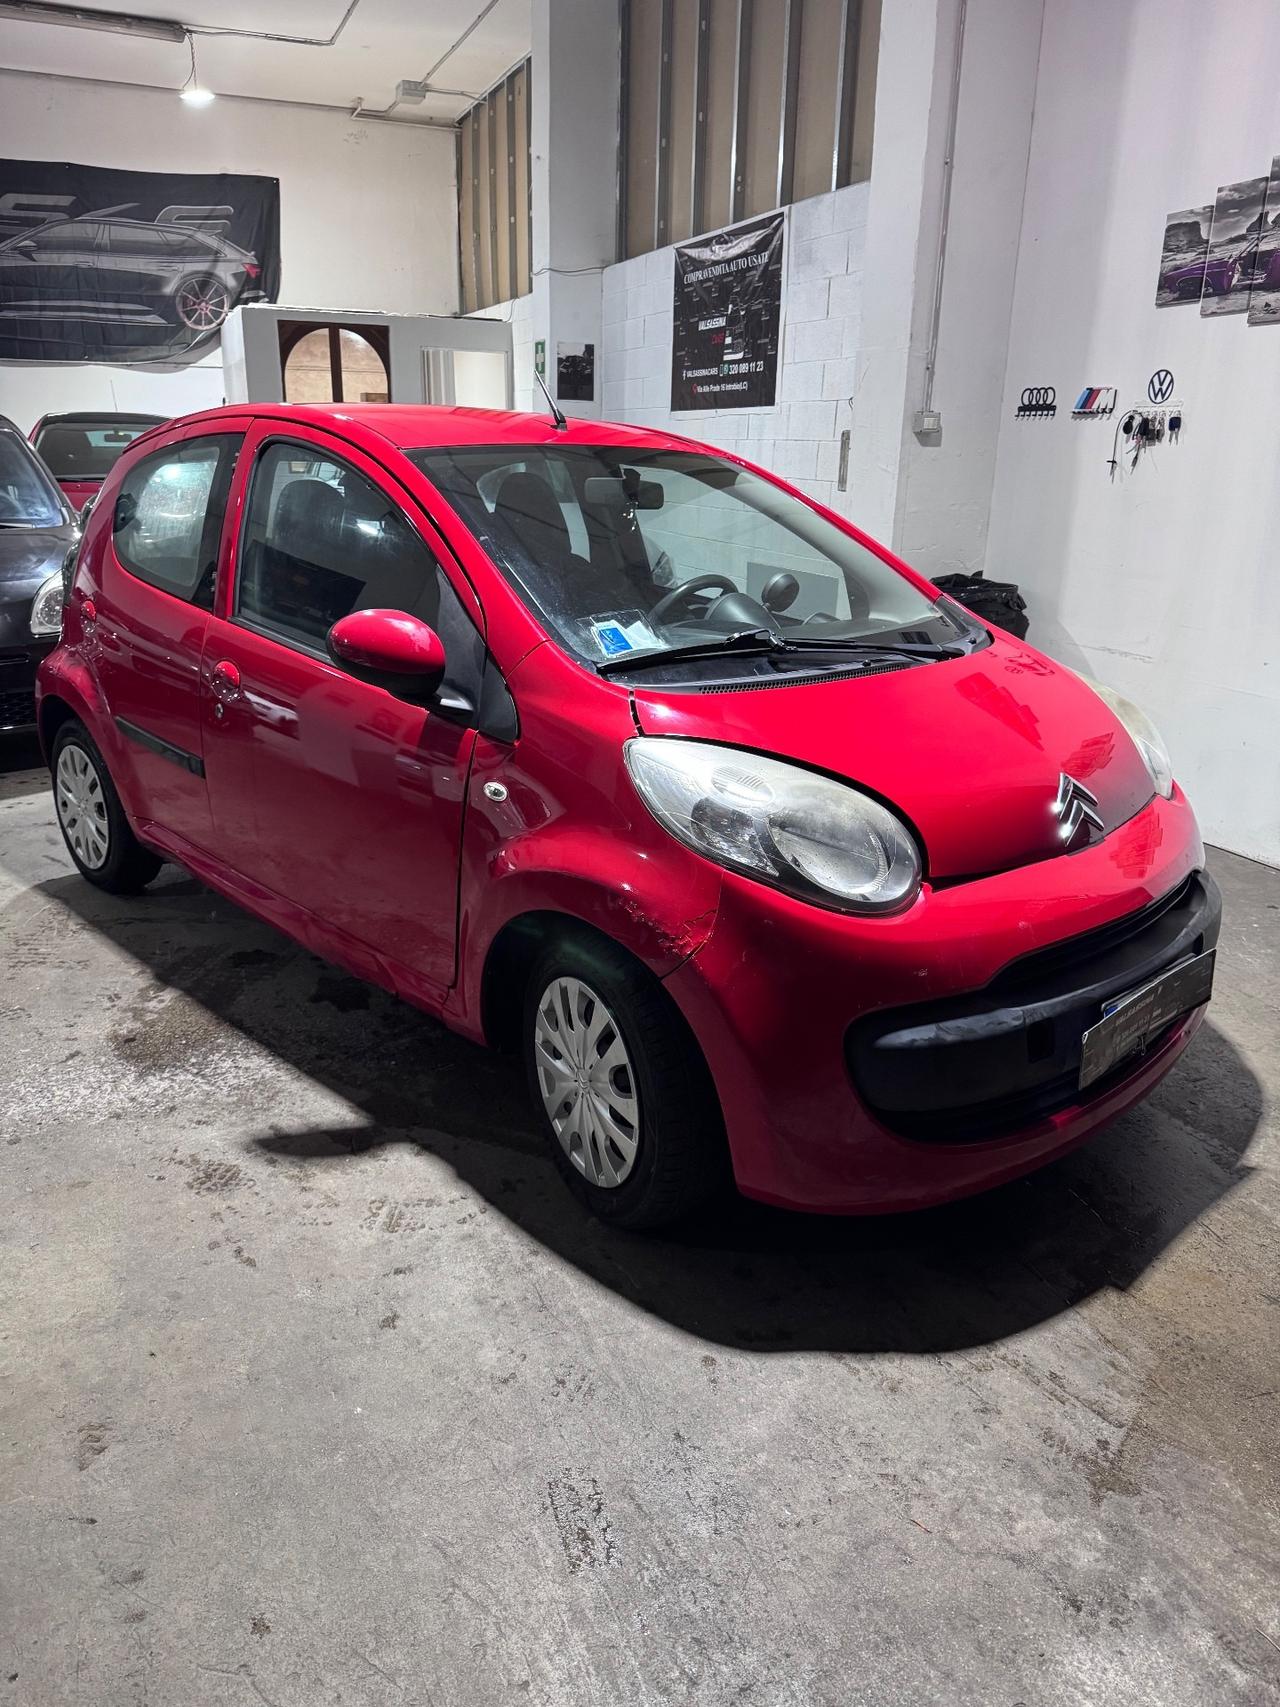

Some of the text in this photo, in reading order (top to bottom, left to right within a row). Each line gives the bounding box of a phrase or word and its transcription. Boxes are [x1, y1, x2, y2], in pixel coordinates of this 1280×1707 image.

[684, 251, 769, 284] COMPRAVENDITA AUTO USATE
[750, 361, 756, 372] 11
[756, 360, 764, 371] 23
